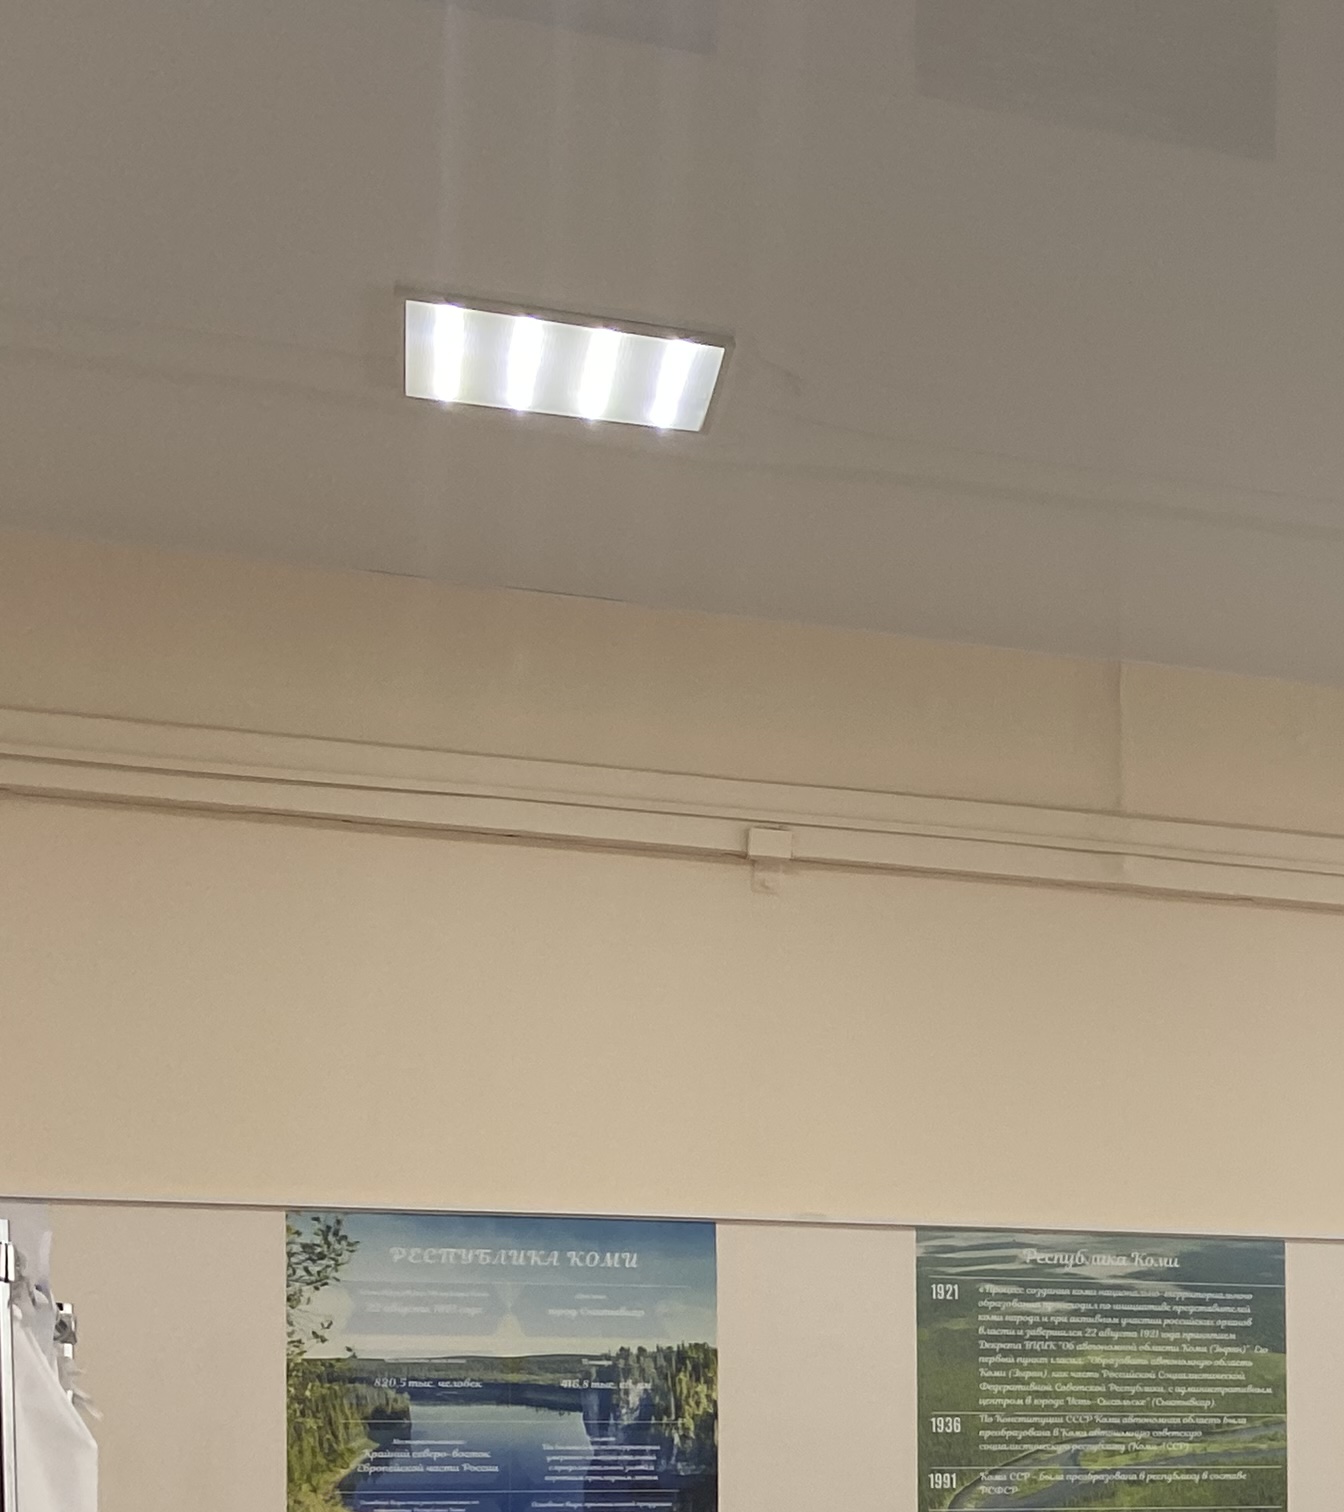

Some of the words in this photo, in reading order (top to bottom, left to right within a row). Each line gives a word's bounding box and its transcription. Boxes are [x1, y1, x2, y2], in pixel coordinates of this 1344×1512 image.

[389, 1247, 559, 1266] РЕСПУБЛИКА
[567, 1251, 637, 1268] КОМИ
[1131, 1252, 1180, 1268] Коми
[931, 1284, 959, 1300] 1921
[1085, 1328, 1097, 1337] 22
[1140, 1329, 1159, 1338] 1921
[1181, 1344, 1207, 1352] Коми
[979, 1369, 1006, 1378] Коми
[930, 1417, 961, 1433] 1936
[1065, 1414, 1093, 1423] СССР
[462, 1463, 499, 1472] России
[928, 1473, 957, 1489] 1991
